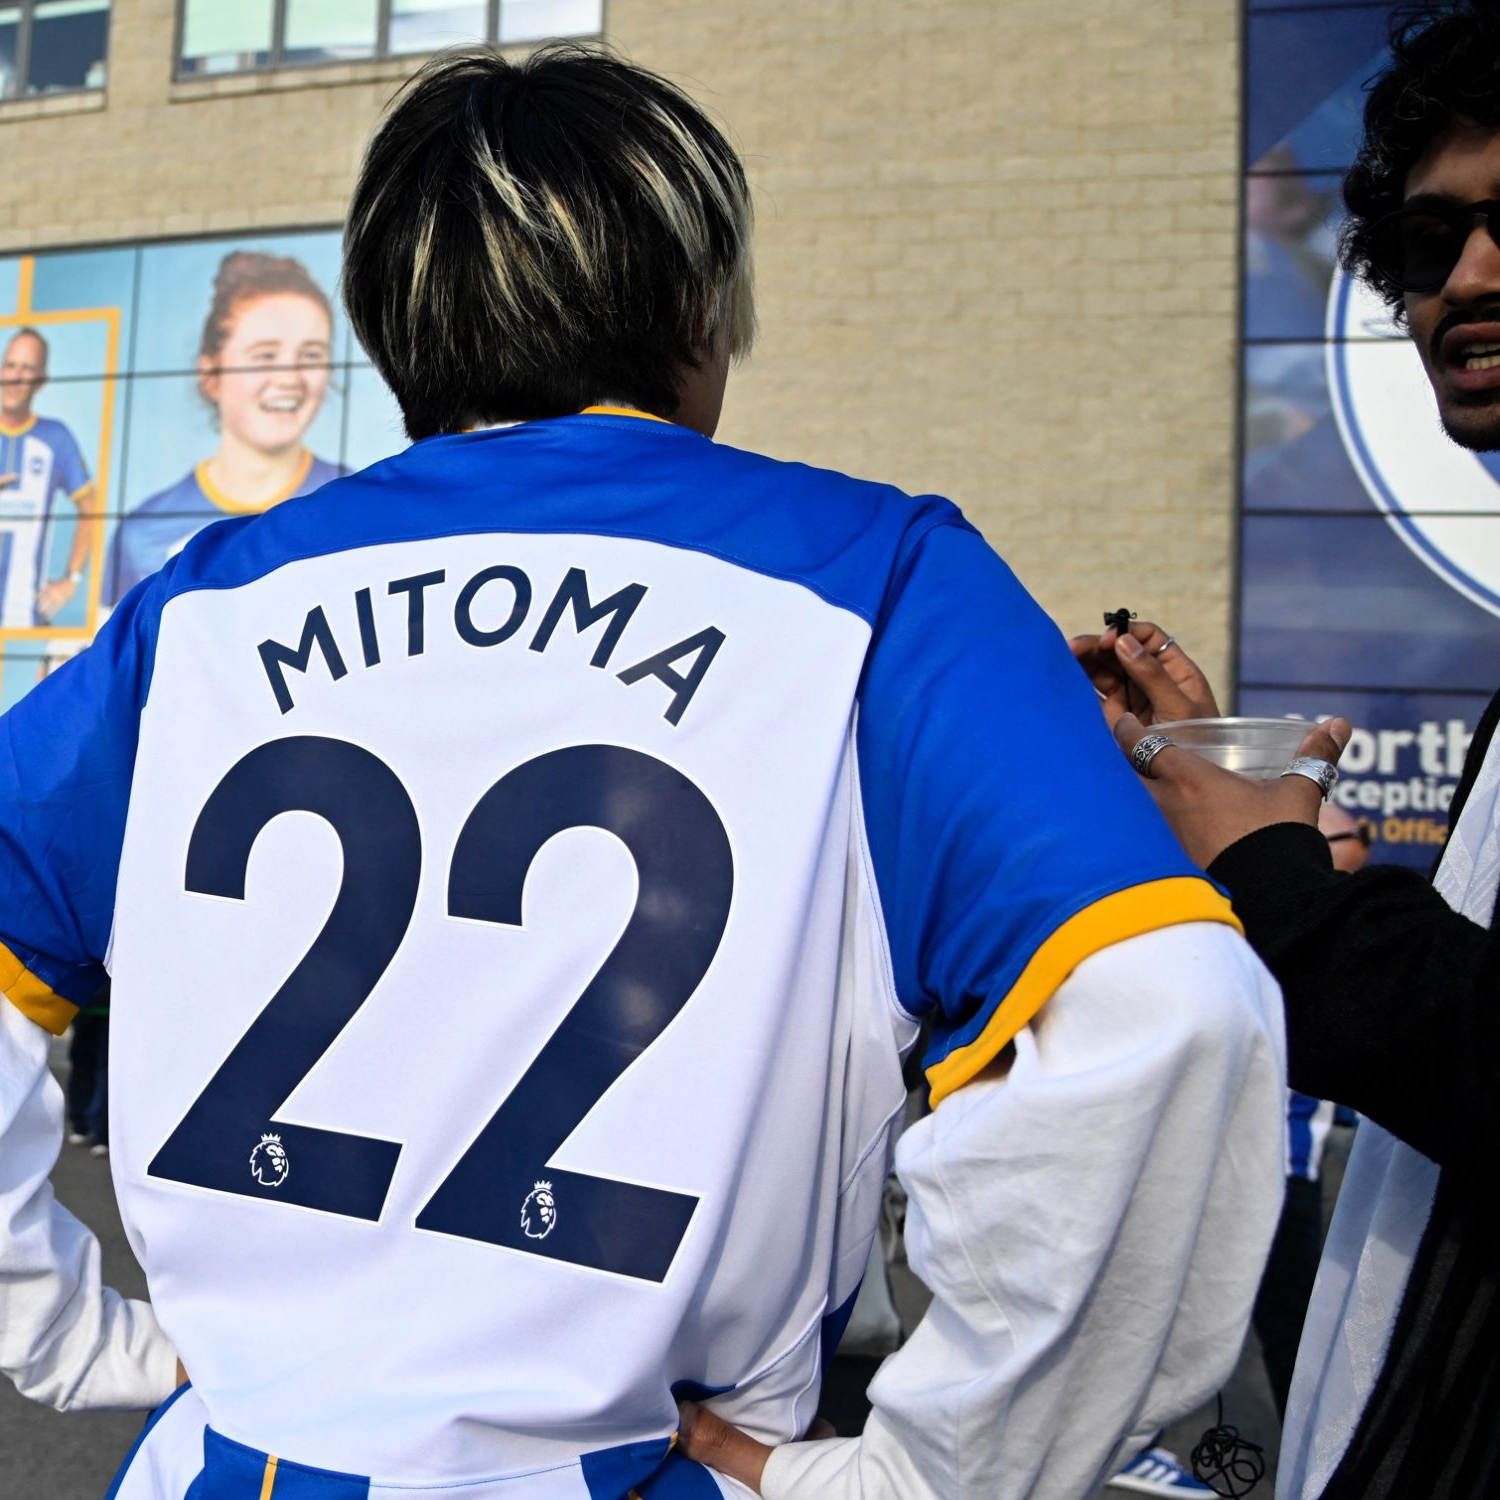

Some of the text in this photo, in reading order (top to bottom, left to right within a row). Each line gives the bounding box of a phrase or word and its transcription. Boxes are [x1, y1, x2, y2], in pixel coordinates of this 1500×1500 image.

[256, 563, 728, 728] MITOMA
[1284, 713, 1475, 777] orth
[145, 734, 736, 1285] 22
